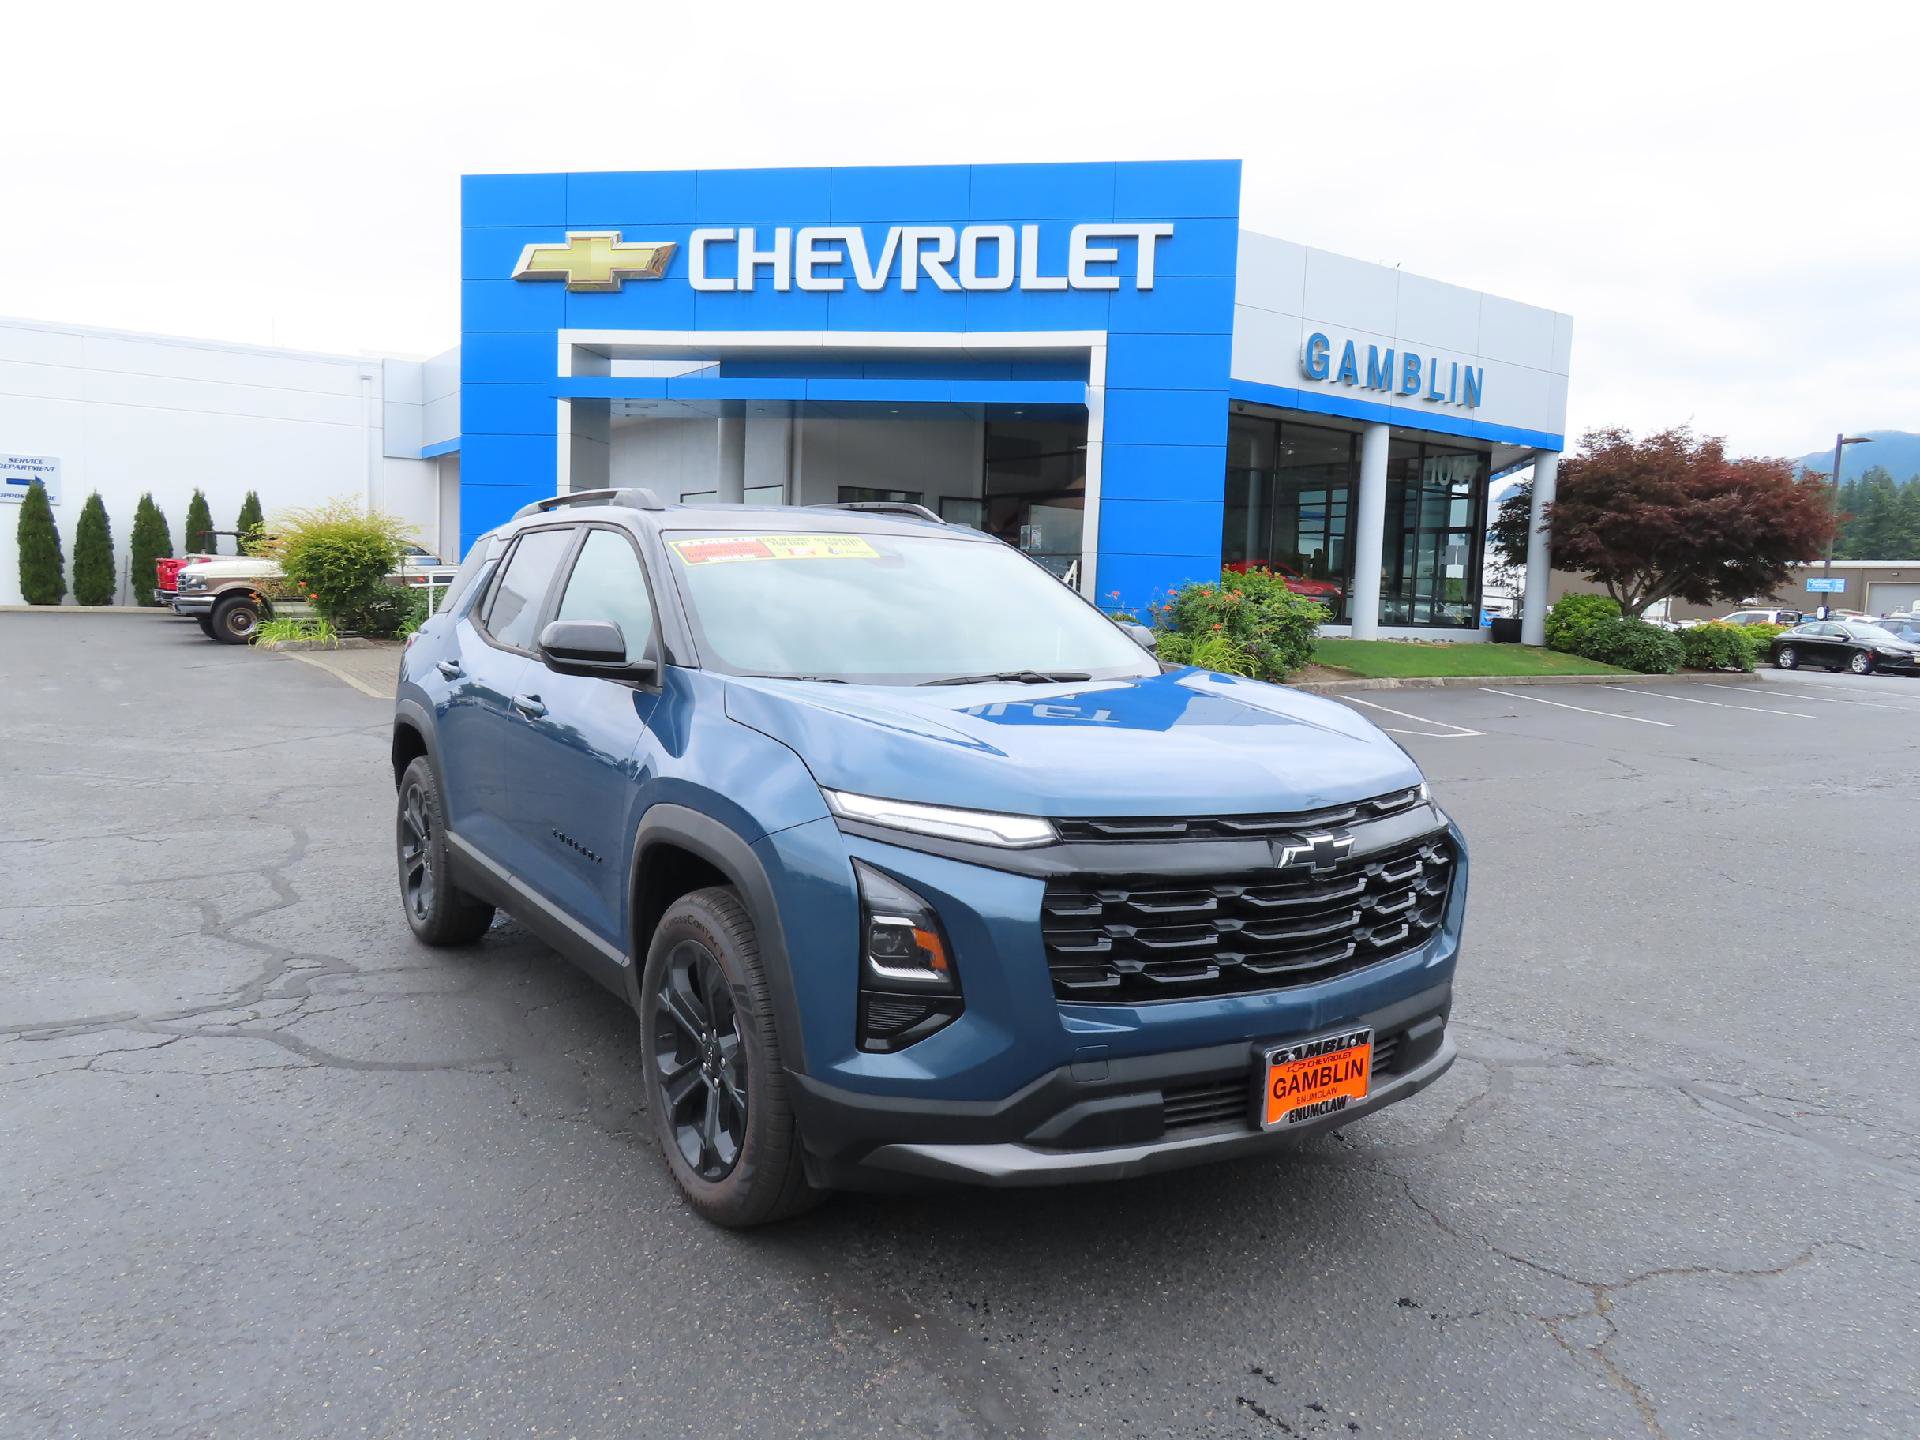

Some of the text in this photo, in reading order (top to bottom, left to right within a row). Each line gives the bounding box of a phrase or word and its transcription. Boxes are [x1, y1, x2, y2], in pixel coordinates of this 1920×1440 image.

[689, 222, 1174, 292] CHEVROLET
[1303, 332, 1484, 408] GAMBLIN
[1272, 1031, 1370, 1065] GAMBLIN
[1307, 1051, 1352, 1068] CHEVROLET
[1272, 1058, 1364, 1100] GAMBLIN
[1296, 1087, 1338, 1105] ENUMCLAW
[1289, 1095, 1348, 1123] ENUMCLAW
